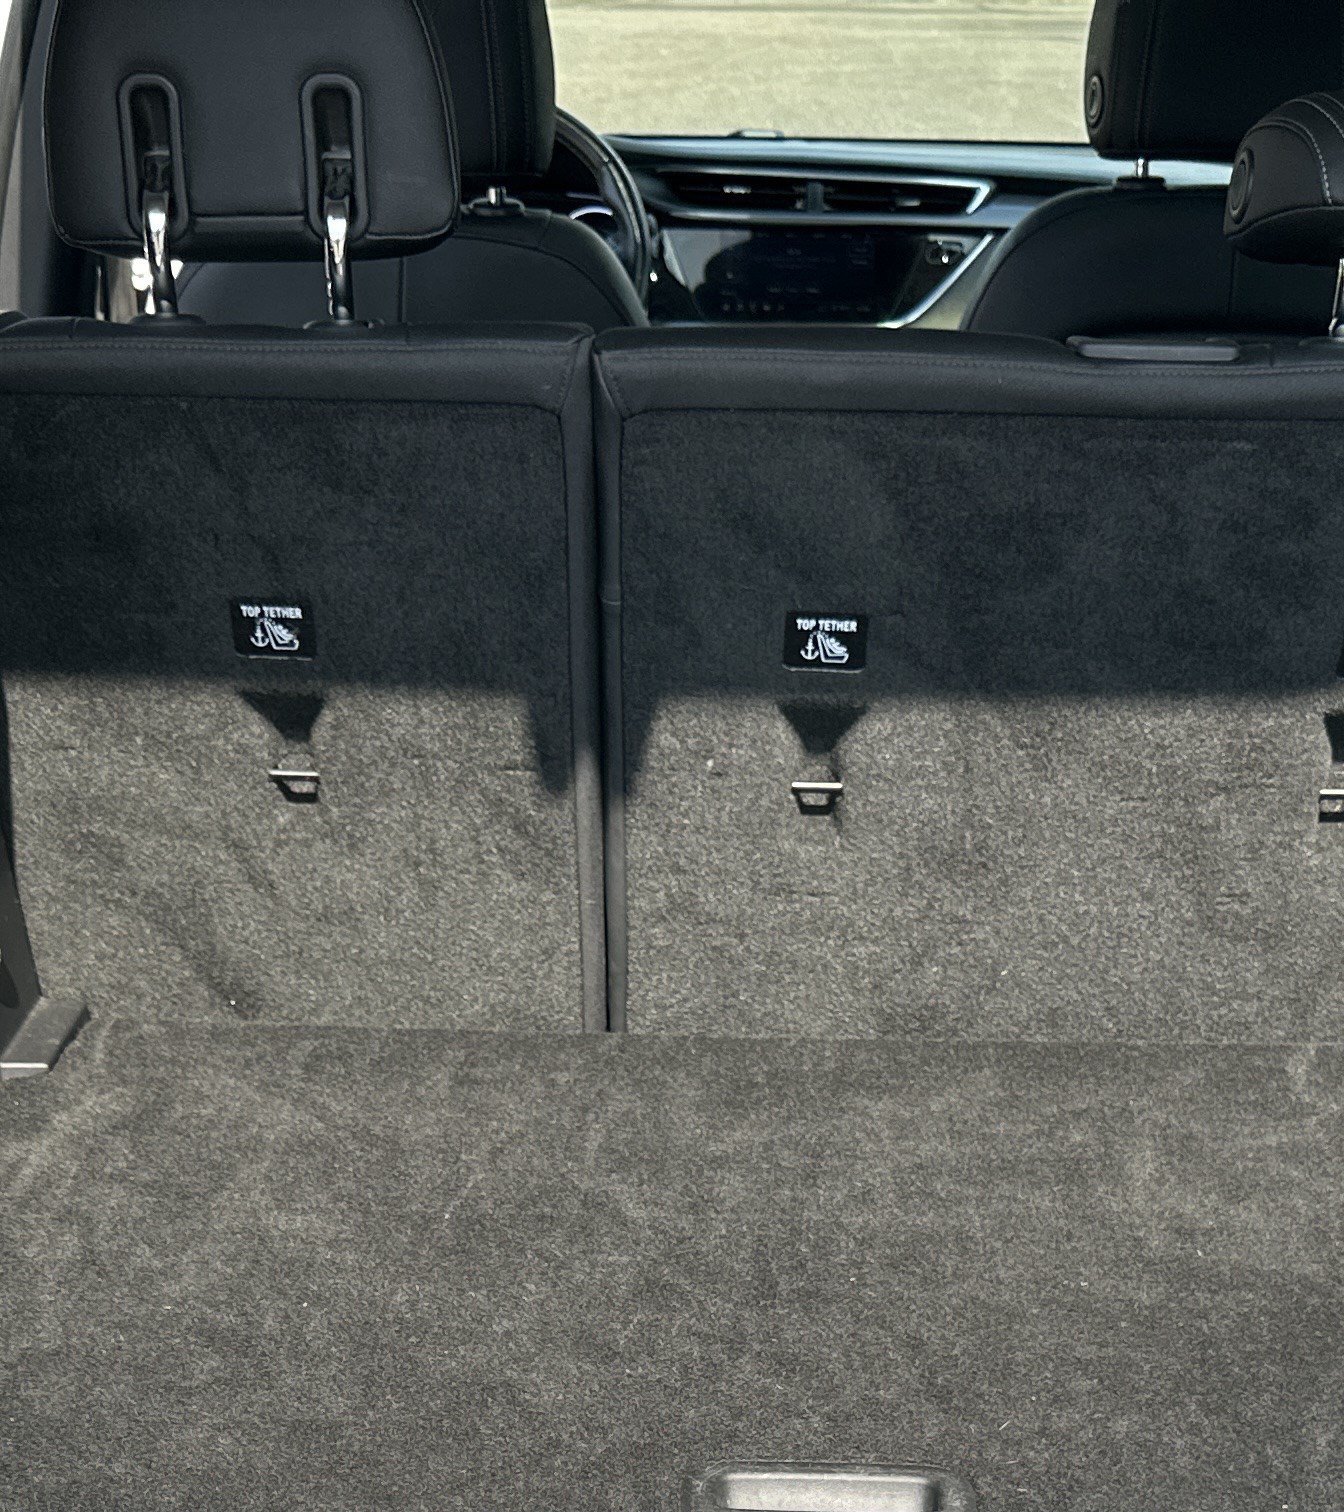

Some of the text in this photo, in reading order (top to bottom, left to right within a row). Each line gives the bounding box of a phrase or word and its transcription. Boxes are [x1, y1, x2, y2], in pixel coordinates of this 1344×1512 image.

[240, 605, 303, 619] TOP TETHER
[796, 619, 858, 633] TOP TETHER
